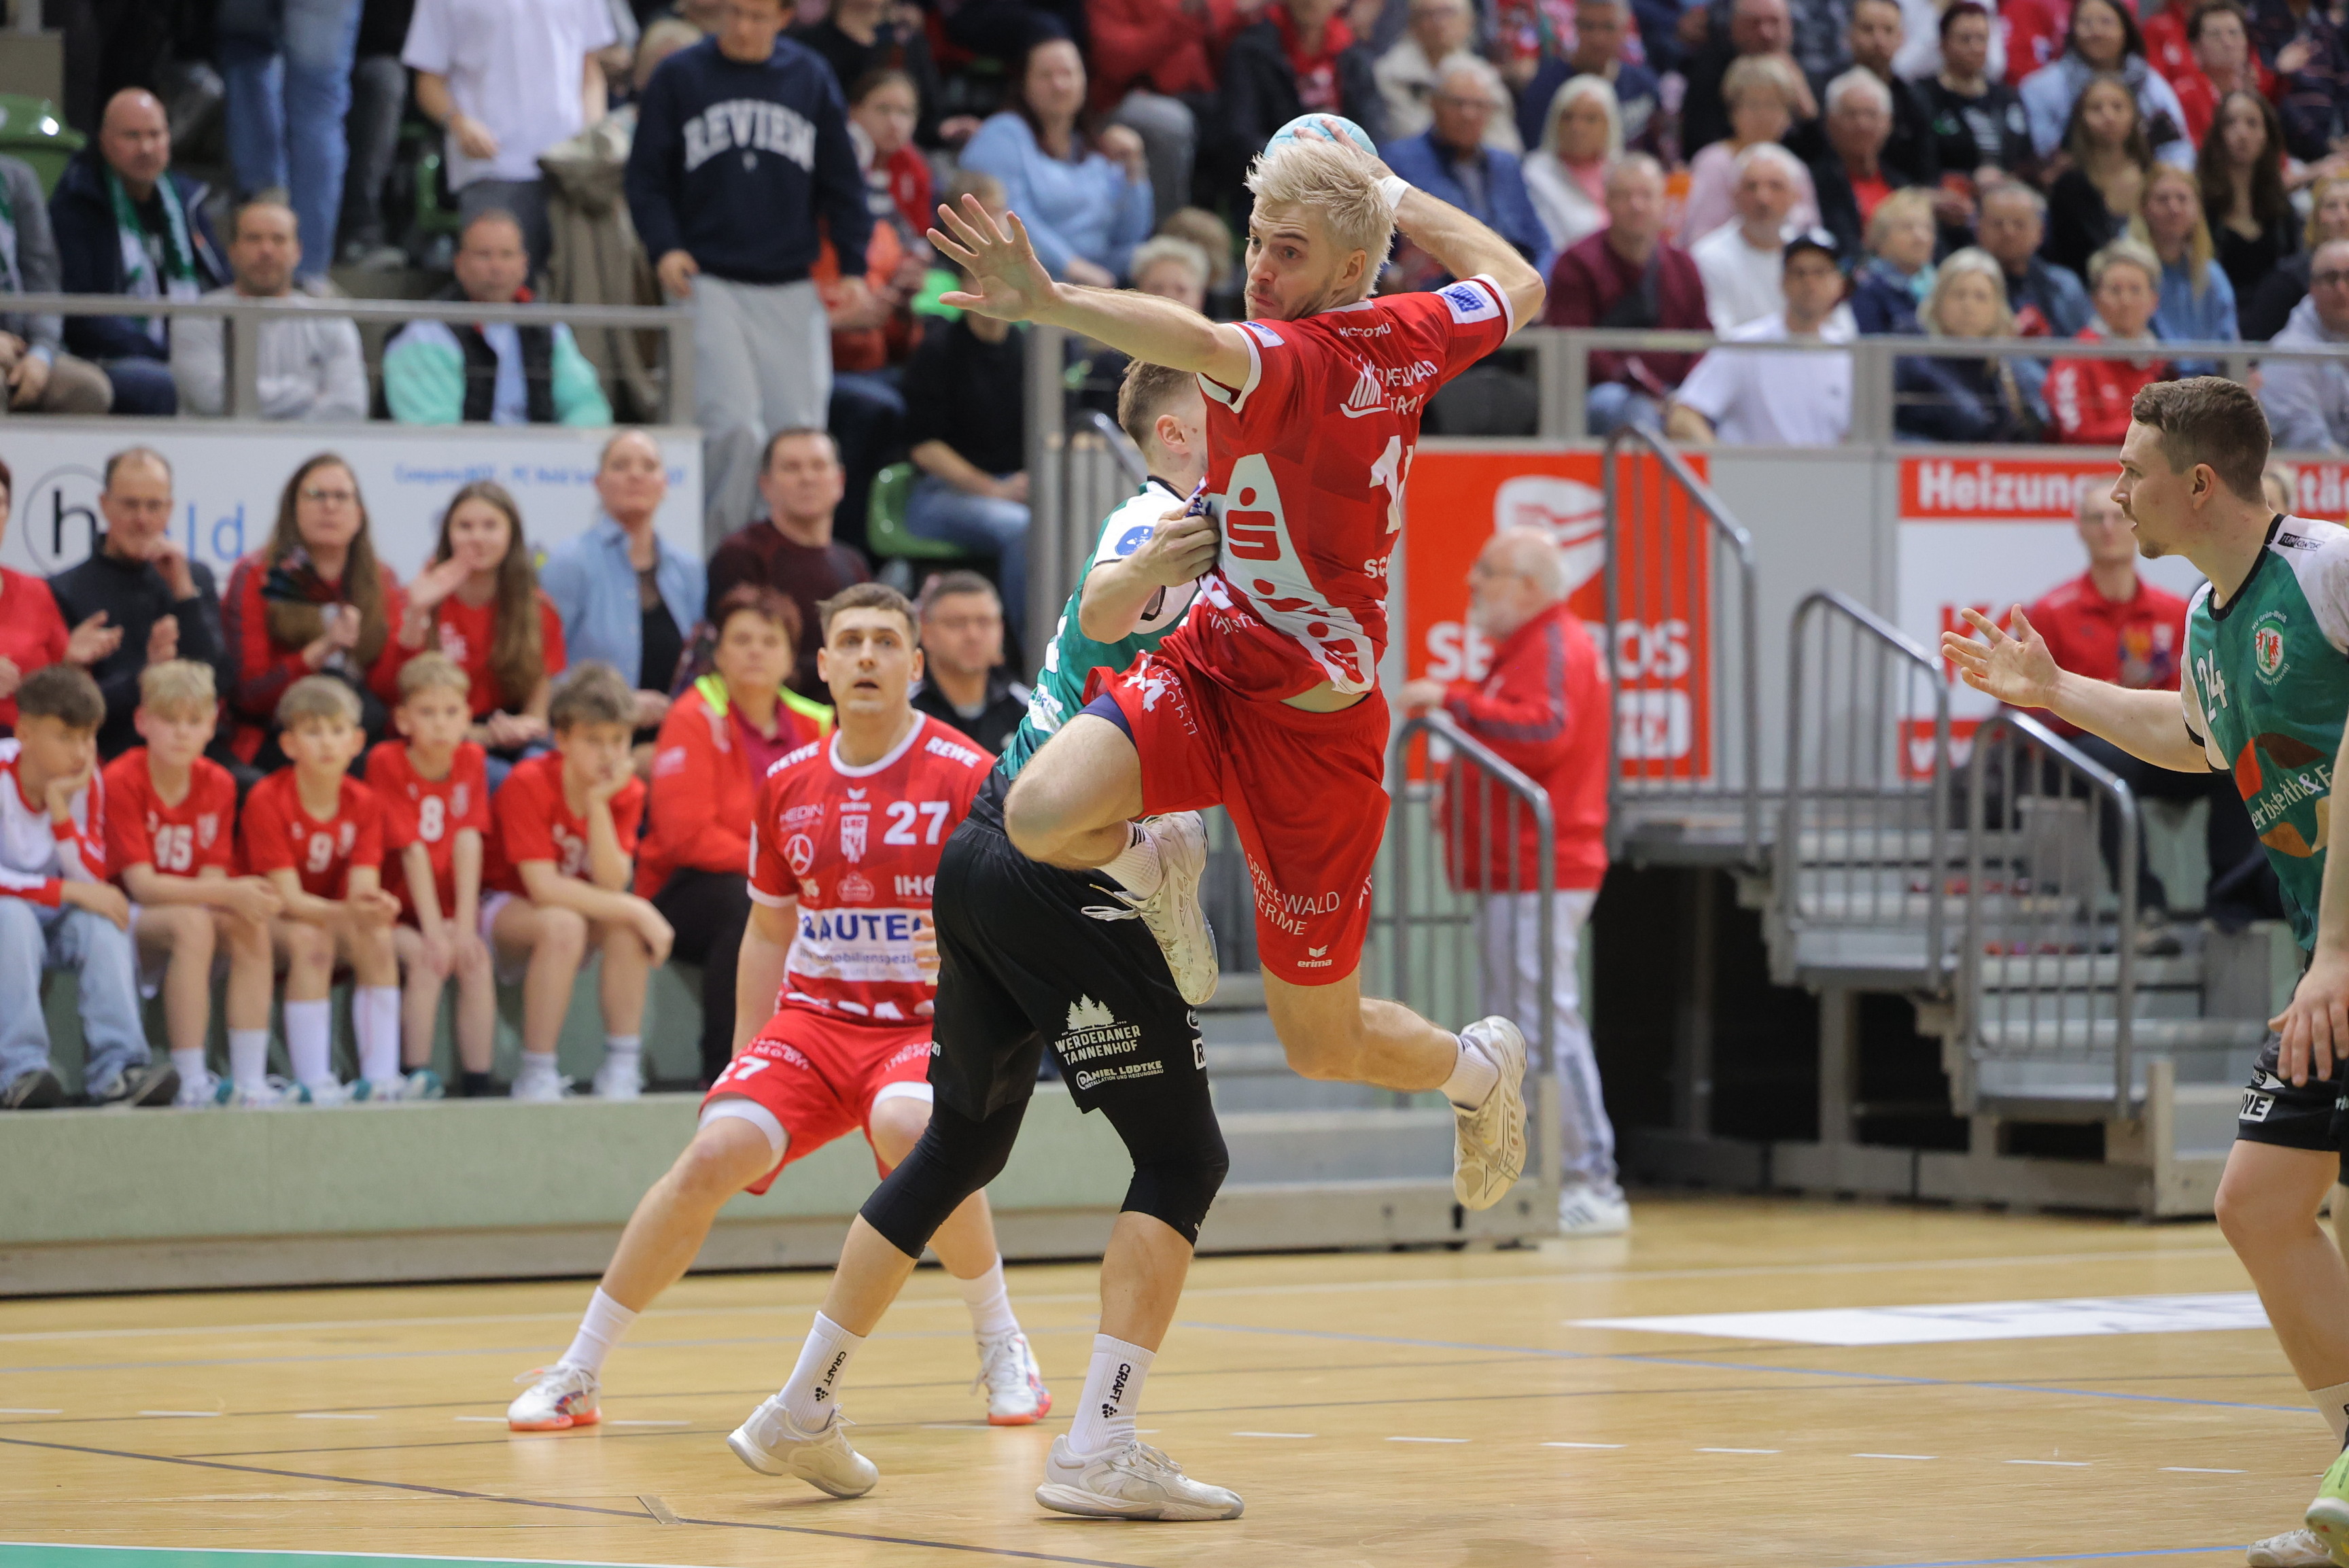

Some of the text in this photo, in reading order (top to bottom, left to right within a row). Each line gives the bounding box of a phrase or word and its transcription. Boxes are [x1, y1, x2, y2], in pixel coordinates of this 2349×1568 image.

[52, 485, 247, 563] hld
[2196, 648, 2227, 724] 24
[924, 735, 982, 769] REWE
[418, 795, 445, 843] 8
[884, 801, 950, 845] 27
[307, 832, 334, 873] 9
[1297, 959, 1332, 968] erima
[1055, 1025, 1141, 1053] WERDERANER
[1064, 1039, 1138, 1066] TANNENHOF
[1079, 1068, 1117, 1085] DANIEL
[823, 1351, 847, 1387] CRAFT
[1109, 1363, 1131, 1404] CRAFT
